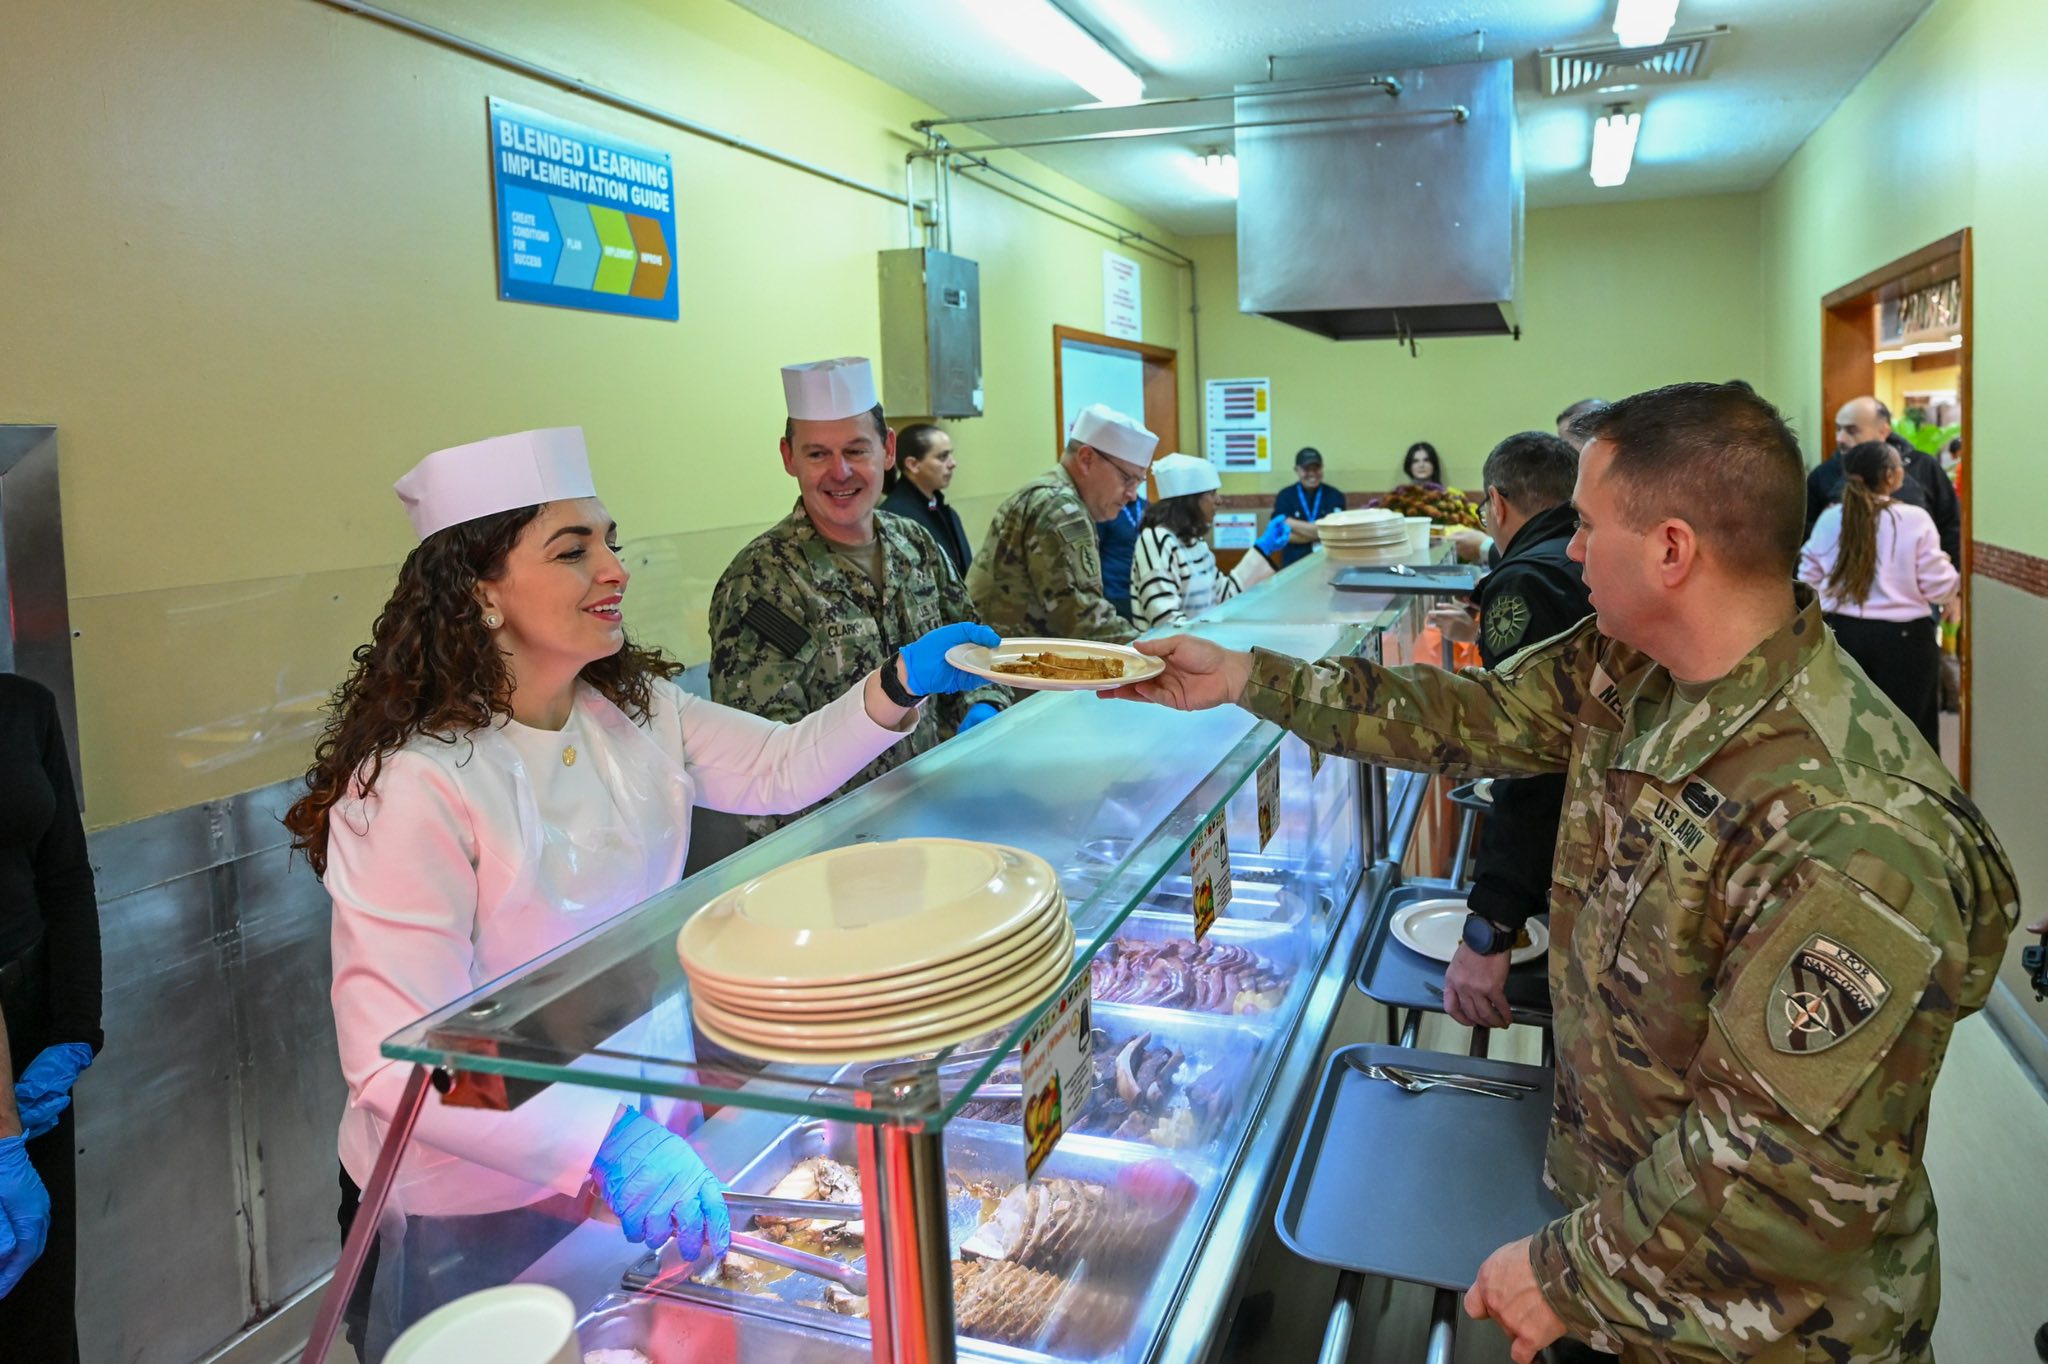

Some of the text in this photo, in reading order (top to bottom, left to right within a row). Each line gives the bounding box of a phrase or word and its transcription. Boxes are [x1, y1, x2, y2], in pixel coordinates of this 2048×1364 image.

[500, 120, 668, 190] BLENDED LEARNING
[502, 152, 670, 212] IMPLEMENTATION GUIDE
[512, 211, 536, 226] CREATE
[512, 226, 550, 243] CONDITIONS
[513, 240, 527, 251] FOR
[566, 238, 582, 250] PLAN
[514, 253, 542, 268] SUCCESS
[828, 623, 859, 637] CLARK
[1654, 798, 1705, 853] U.S. ARMY
[1836, 949, 1870, 979] KFOR
